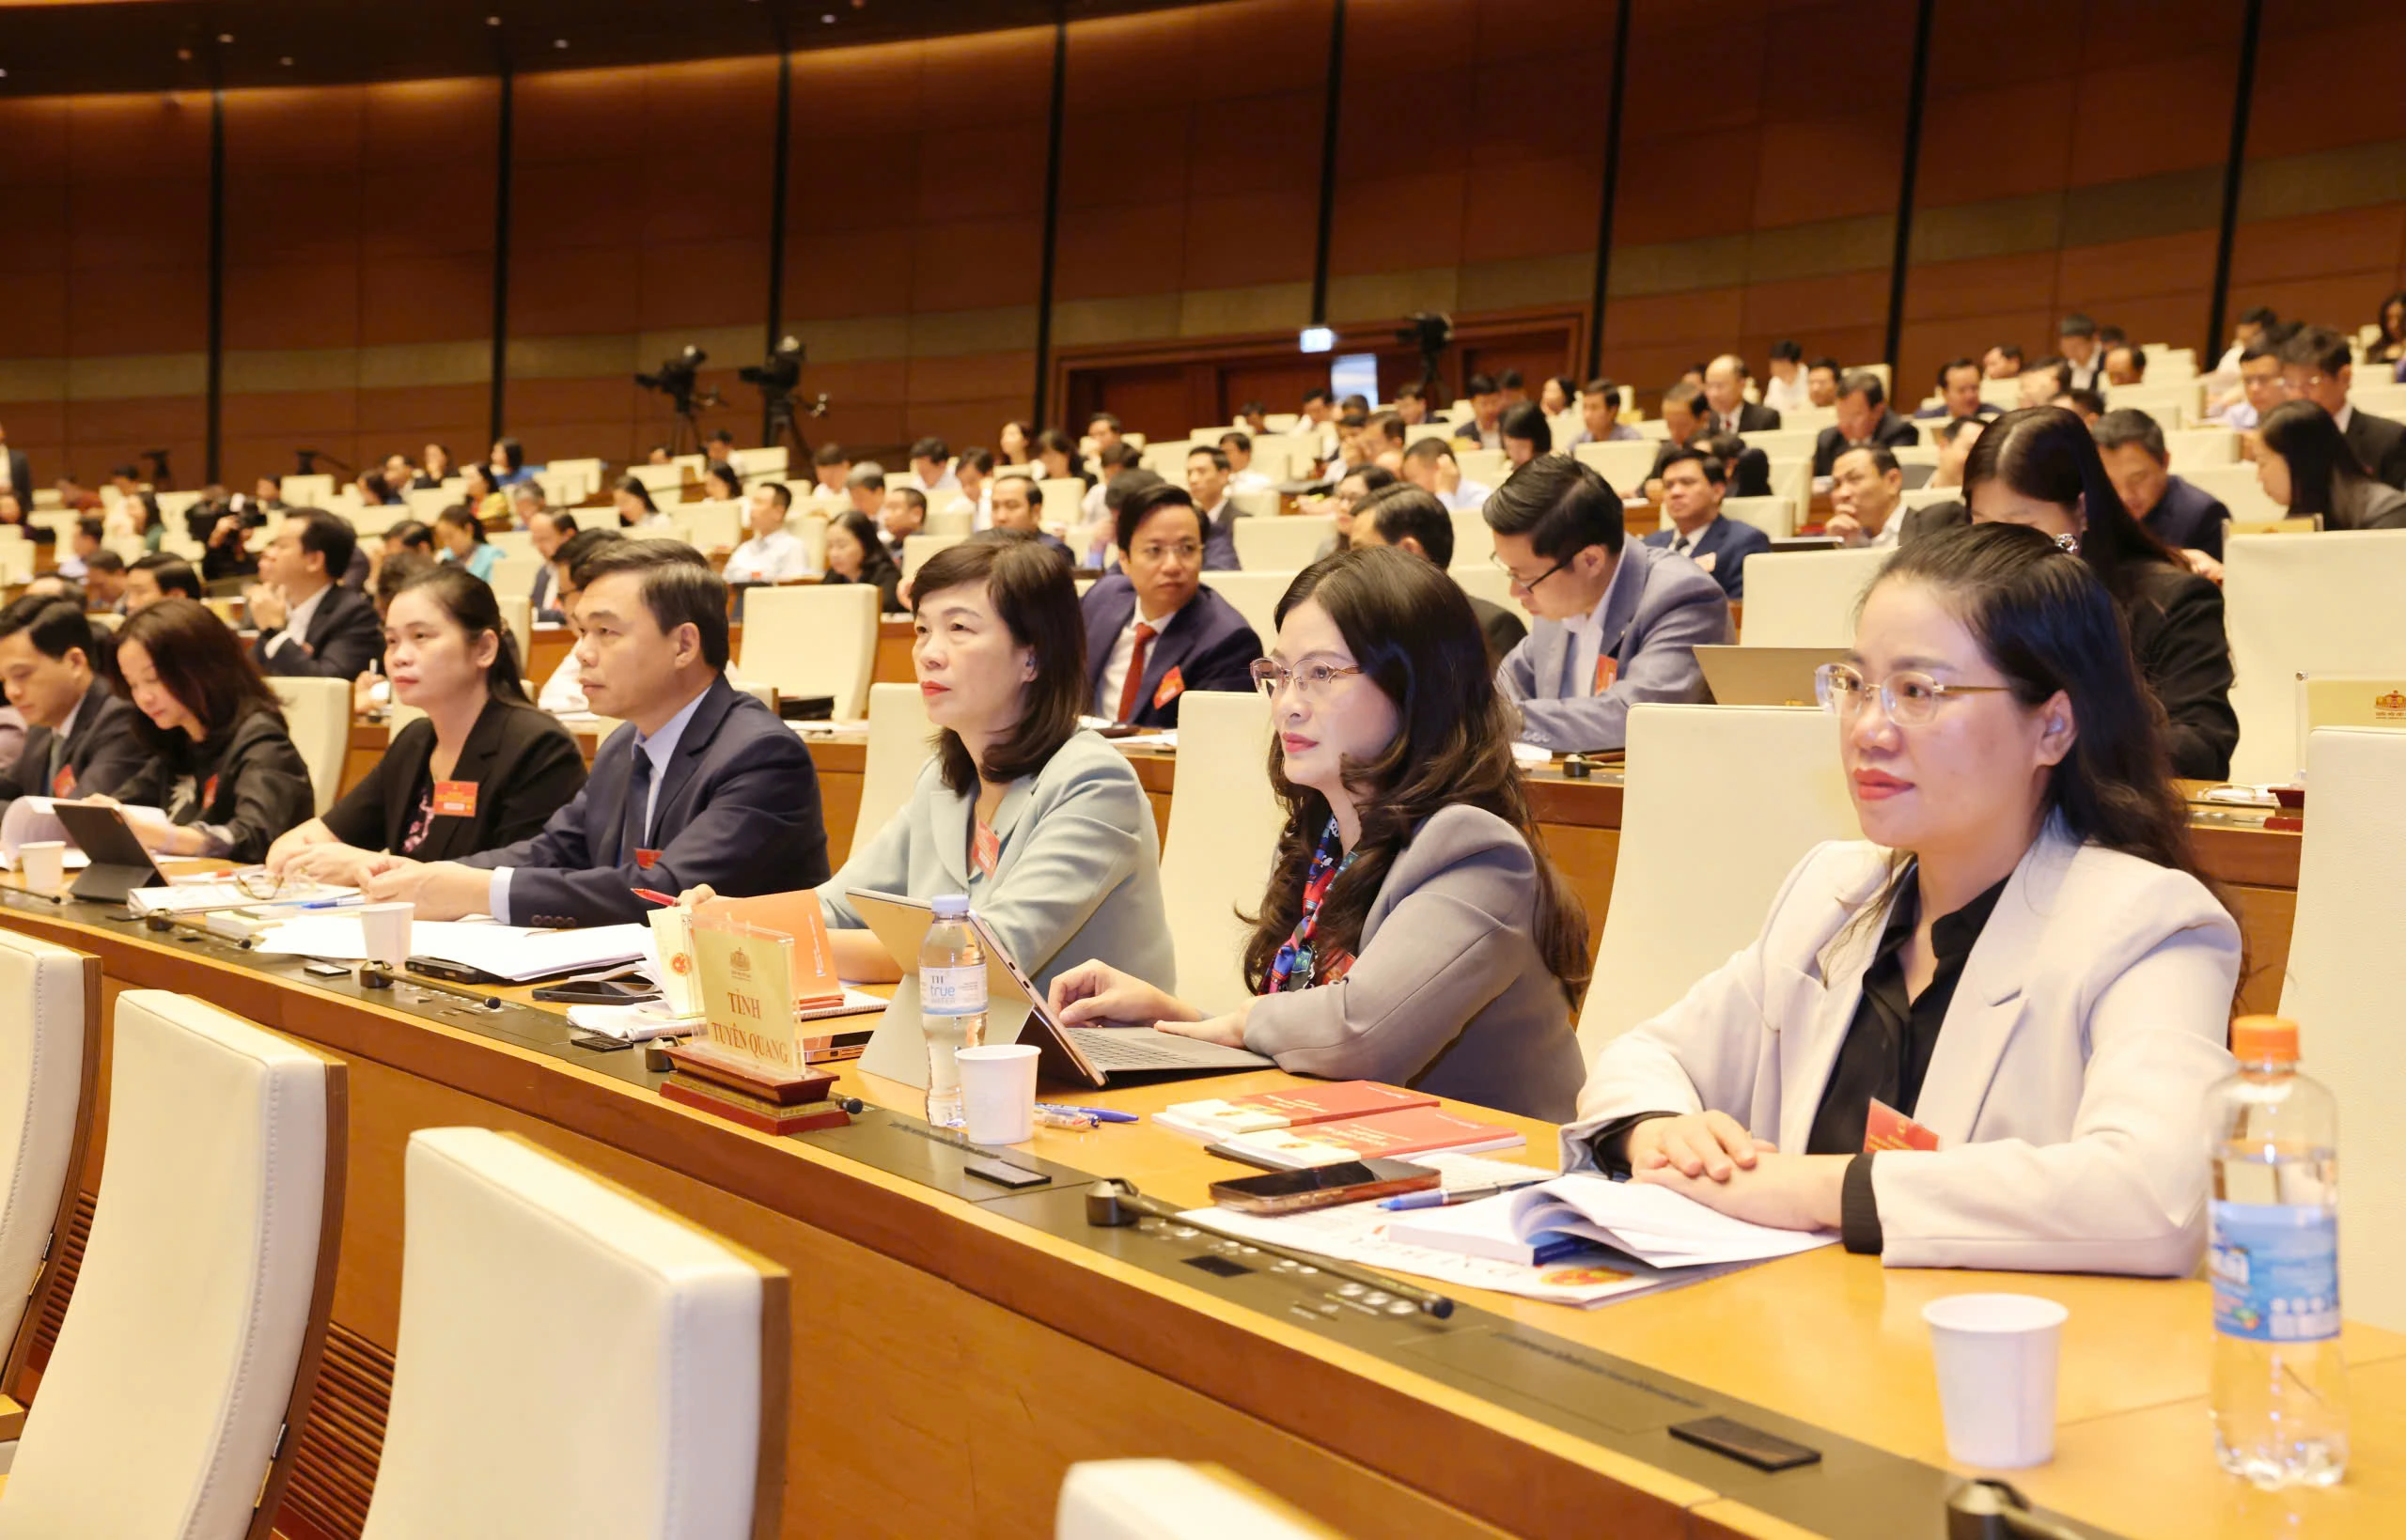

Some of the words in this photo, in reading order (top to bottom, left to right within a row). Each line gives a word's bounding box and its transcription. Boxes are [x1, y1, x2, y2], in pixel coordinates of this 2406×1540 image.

[727, 988, 760, 1019] TỈNH
[930, 985, 955, 996] true
[711, 1022, 747, 1050] TUYÊN
[749, 1033, 788, 1064] QUANG
